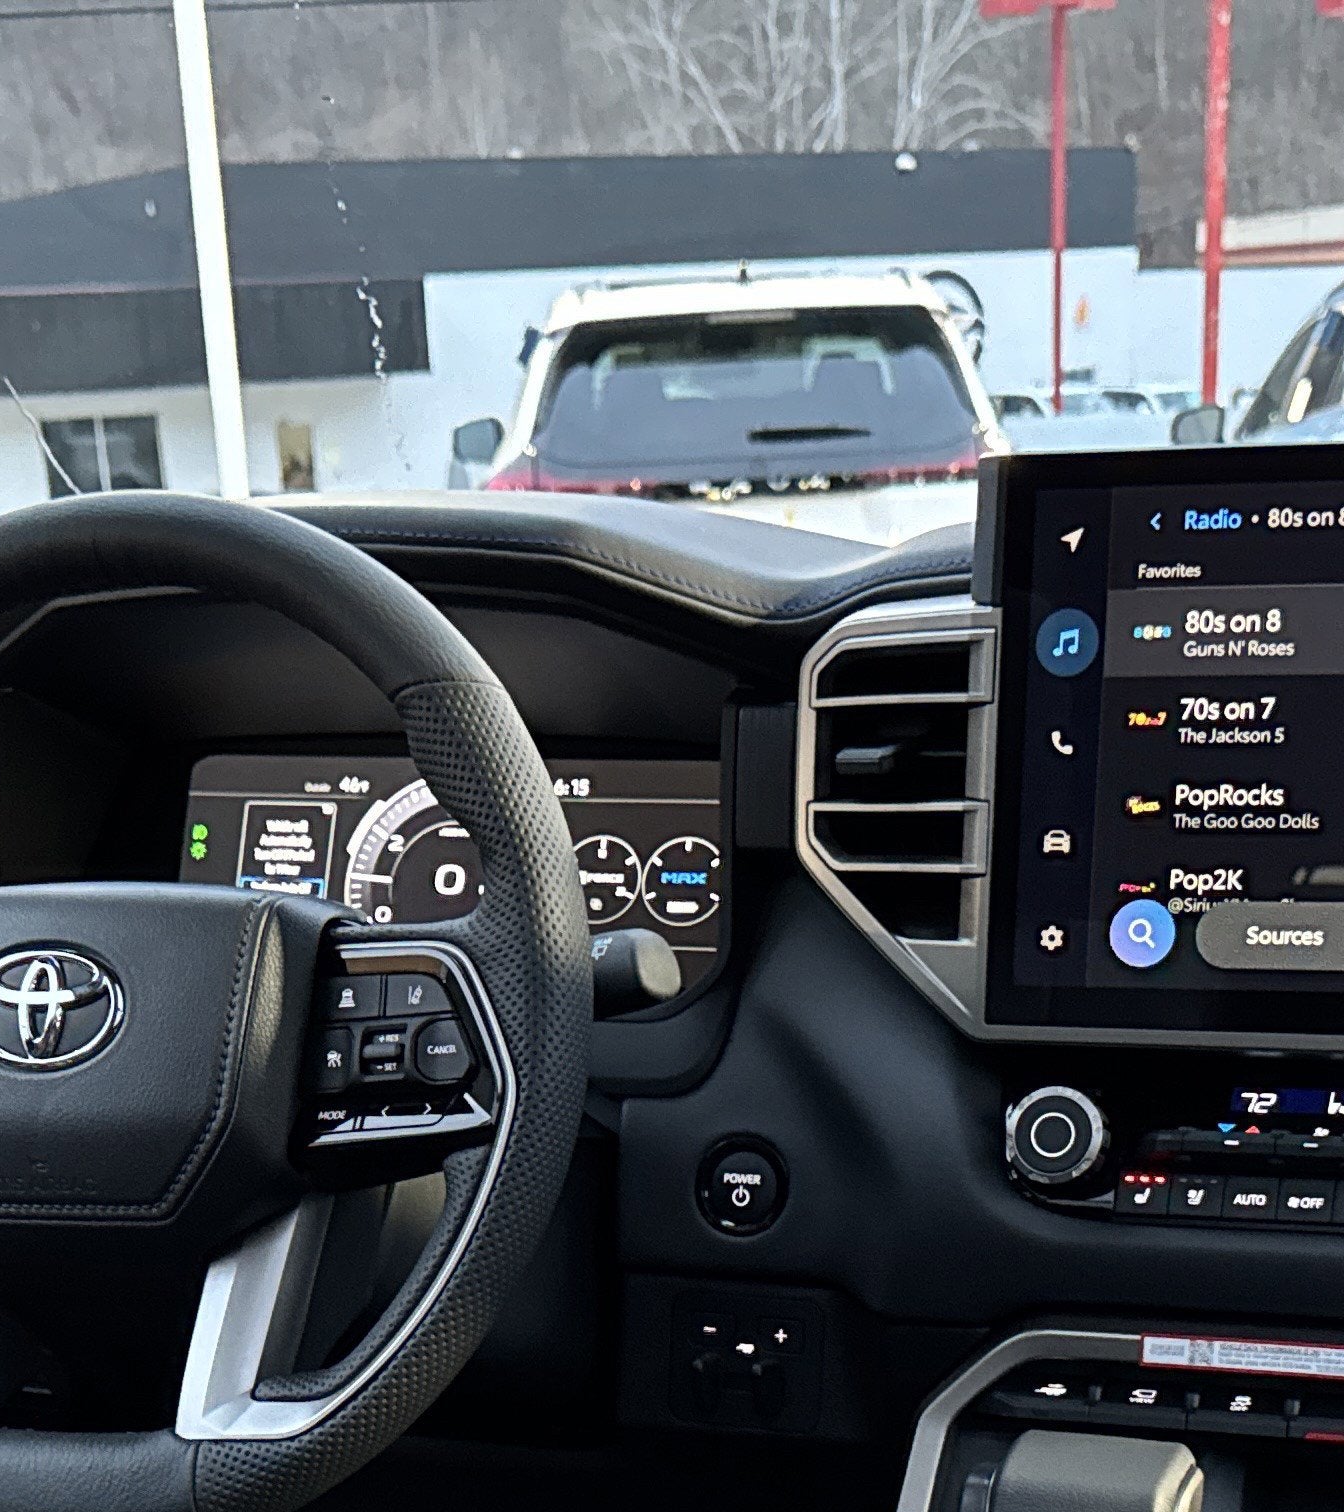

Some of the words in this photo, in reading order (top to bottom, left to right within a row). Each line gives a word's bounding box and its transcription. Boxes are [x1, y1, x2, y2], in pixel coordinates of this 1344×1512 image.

[1184, 509, 1242, 530] Radio
[1267, 508, 1303, 529] 80s
[1307, 511, 1333, 528] on
[1138, 563, 1202, 580] Favorites
[1185, 610, 1225, 634] 80s
[1230, 614, 1261, 633] on
[1265, 609, 1282, 633] 8
[1183, 641, 1225, 658] Guns
[1228, 640, 1246, 657] N'
[1247, 640, 1295, 657] Roses
[1180, 698, 1219, 721] 70s
[1224, 702, 1256, 720] on
[1260, 697, 1276, 719] 7
[1179, 728, 1206, 745] The
[1207, 728, 1271, 746] Jackson
[1273, 727, 1285, 744] 5
[553, 778, 590, 797] 6:15
[1175, 784, 1284, 811] PopRocks
[1173, 813, 1200, 830] The
[1203, 813, 1238, 830] Goo
[1240, 813, 1276, 830] Goo
[1279, 813, 1320, 830] Dolls
[388, 834, 405, 852] 2
[434, 864, 466, 895] 0
[661, 872, 707, 885] MAX
[1170, 869, 1243, 895] Pop2K
[1246, 926, 1324, 946] Sources
[427, 1044, 457, 1055] CANCEL
[1241, 1092, 1277, 1114] 72
[318, 1110, 348, 1120] MODE
[723, 1173, 762, 1186] POWER
[1233, 1194, 1267, 1207] AUTO
[1301, 1197, 1325, 1210] OFF
